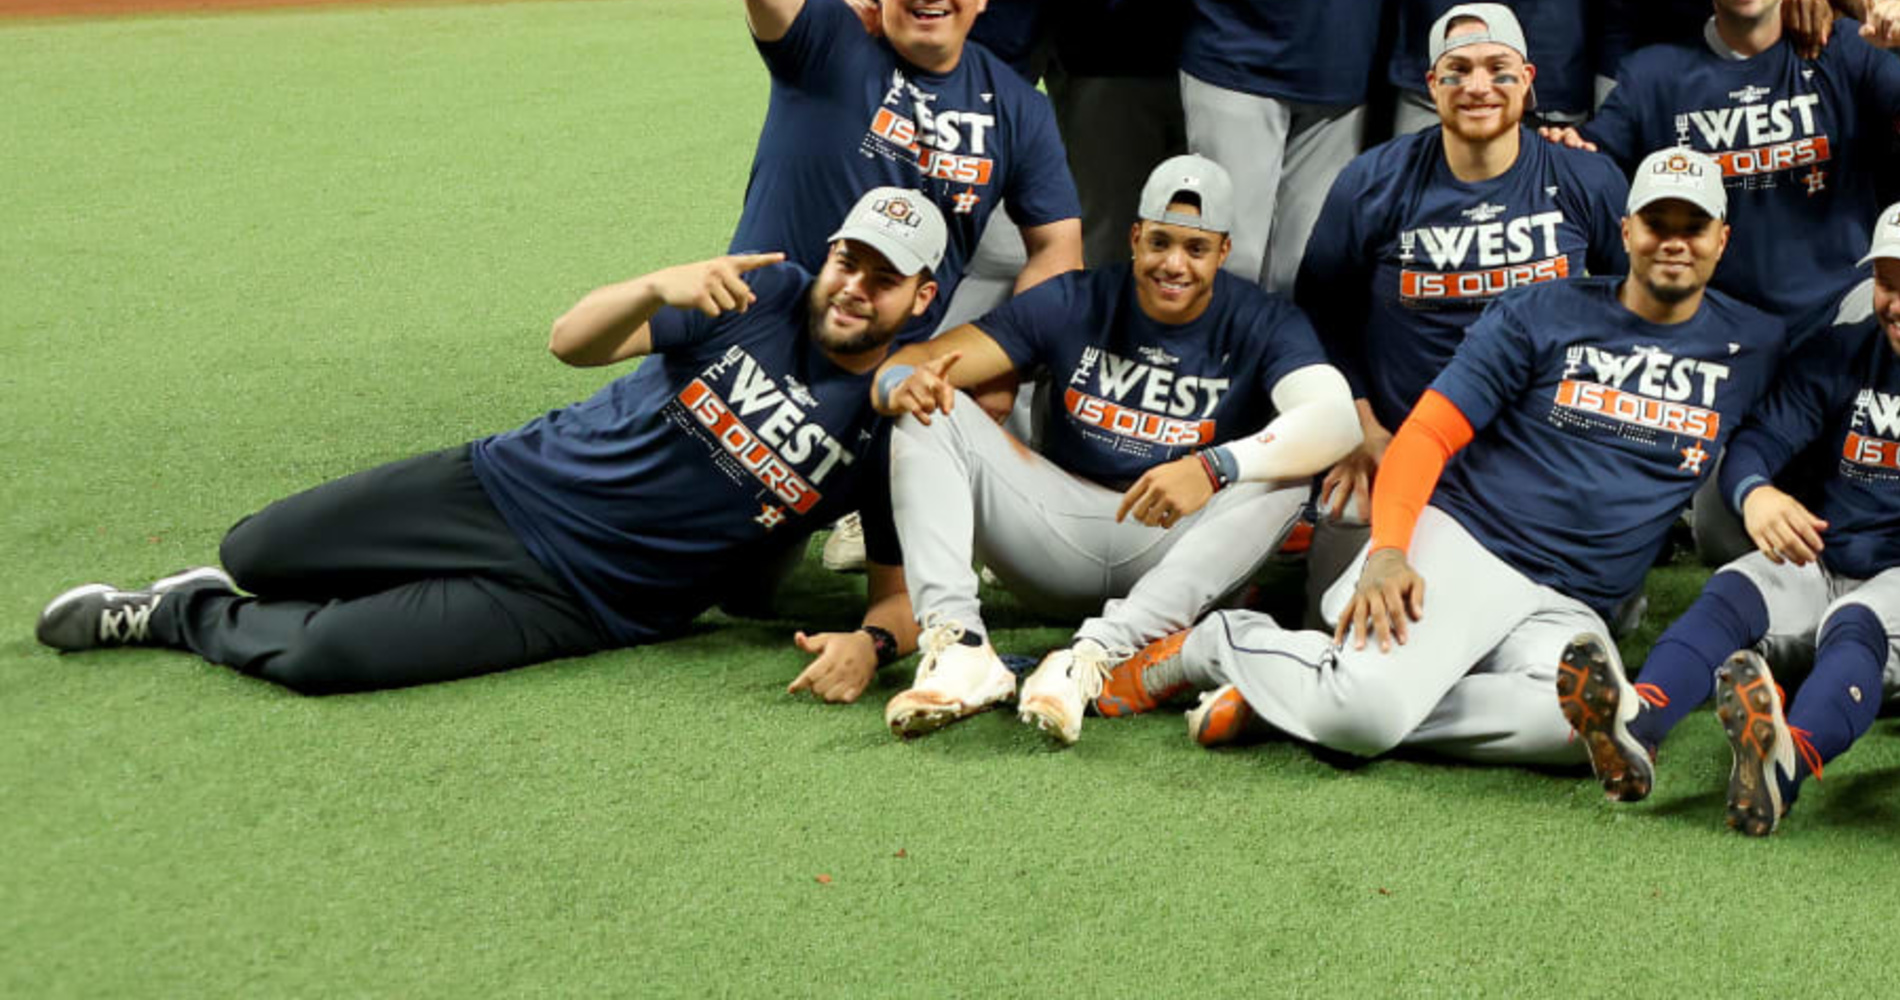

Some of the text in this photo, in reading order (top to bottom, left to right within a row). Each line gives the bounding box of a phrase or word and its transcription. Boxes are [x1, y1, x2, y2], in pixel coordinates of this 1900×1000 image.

[1690, 93, 1820, 151] WEST
[1732, 138, 1817, 175] OURS
[1416, 210, 1564, 270] WEST
[1414, 273, 1446, 297] IS
[1070, 345, 1230, 419] THE WEST
[1583, 345, 1730, 408] WEST
[702, 344, 745, 381] THE
[728, 353, 856, 486] WEST
[1073, 394, 1107, 424] IS
[1113, 409, 1201, 445] OURS
[1571, 385, 1603, 409] IS
[1614, 396, 1709, 437] OURS
[691, 391, 726, 426] IS
[721, 424, 809, 504] OURS
[1855, 438, 1883, 463] IS
